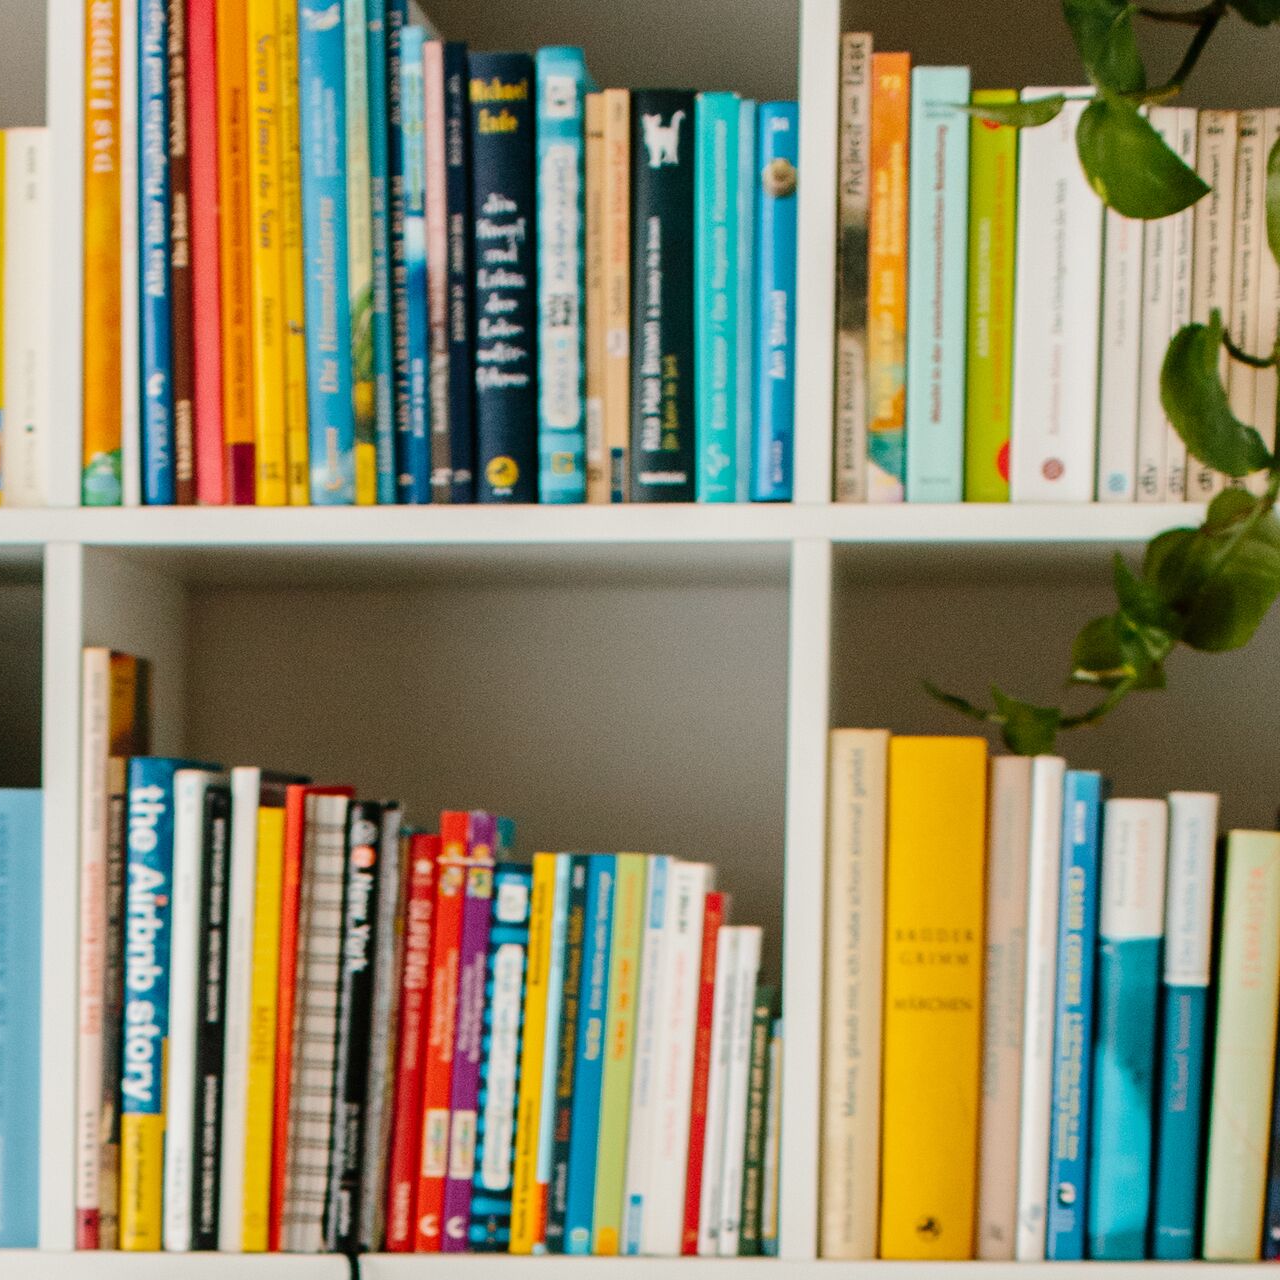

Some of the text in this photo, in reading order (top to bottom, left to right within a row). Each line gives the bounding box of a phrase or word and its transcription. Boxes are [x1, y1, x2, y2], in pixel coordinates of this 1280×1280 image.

[123, 786, 167, 1101] the Airbnb story
[346, 873, 372, 973] New York
